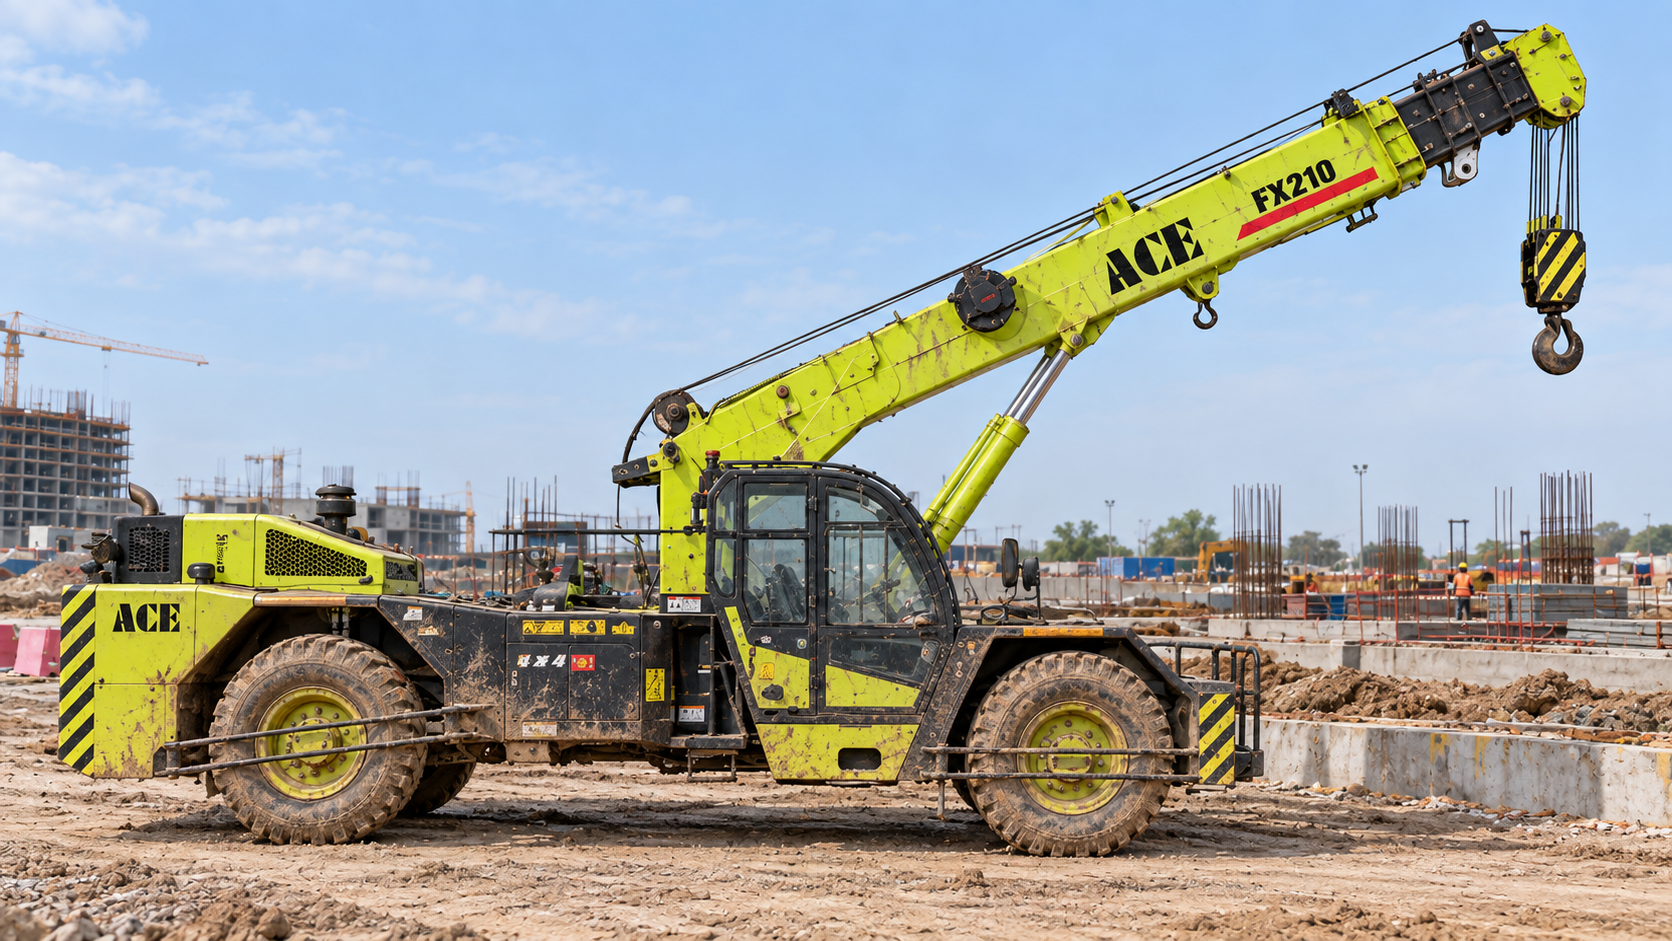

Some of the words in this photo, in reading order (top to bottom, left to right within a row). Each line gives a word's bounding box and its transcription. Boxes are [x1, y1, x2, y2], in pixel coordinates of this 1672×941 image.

[1250, 159, 1337, 214] FX210
[1106, 216, 1205, 296] ACE
[112, 603, 181, 633] ACE
